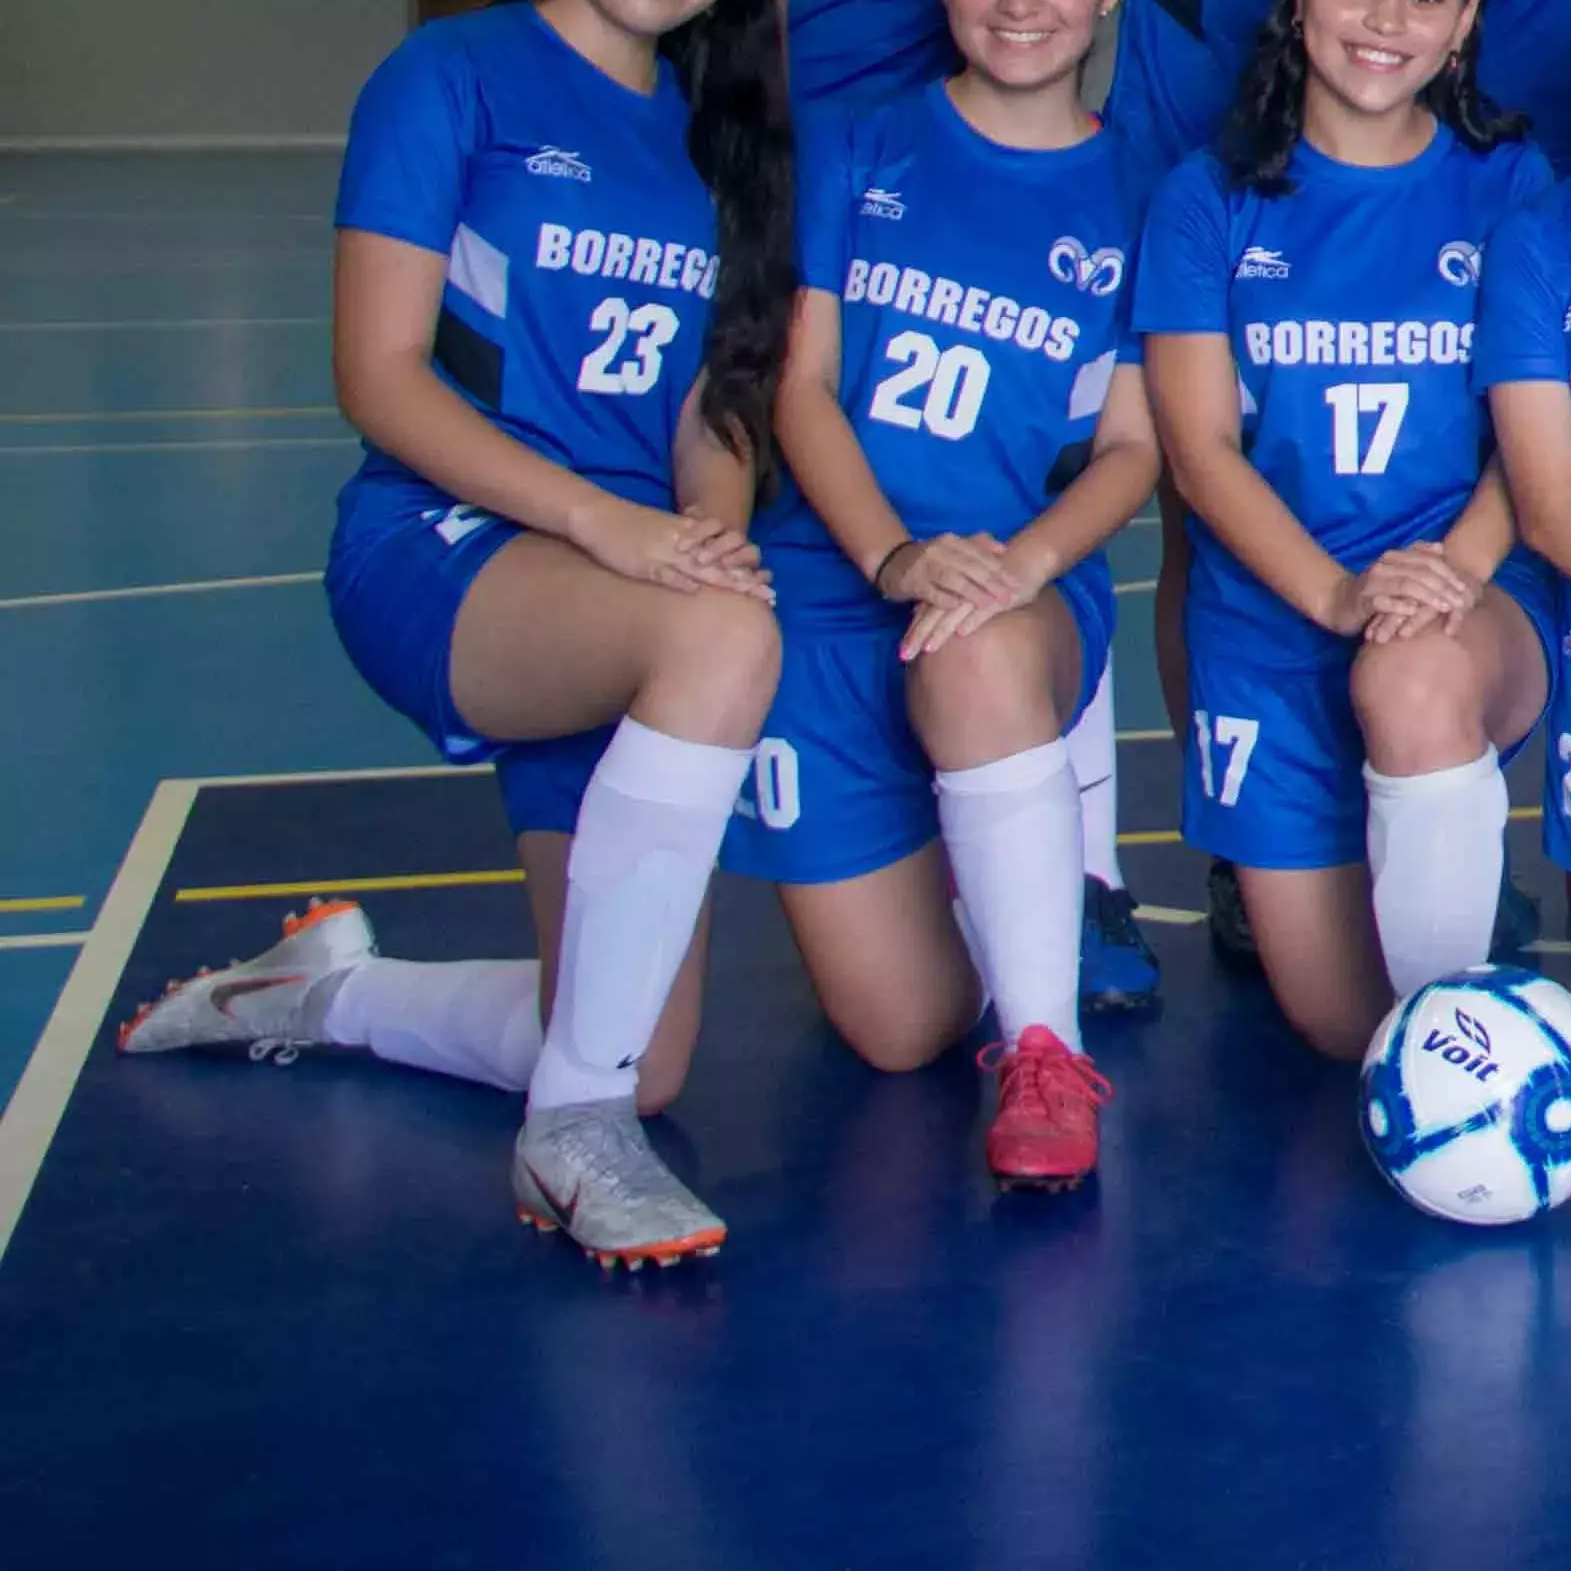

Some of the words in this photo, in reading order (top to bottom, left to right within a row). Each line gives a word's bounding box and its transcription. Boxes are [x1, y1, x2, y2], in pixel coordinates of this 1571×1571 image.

[536, 222, 721, 300] BORREGO
[577, 297, 680, 396] 23
[845, 258, 1083, 362] BORREGOS
[1246, 321, 1475, 365] BORREGOS
[868, 331, 991, 441] 20
[1325, 383, 1409, 475] 17
[735, 737, 800, 831] 0
[1194, 709, 1260, 807] 17
